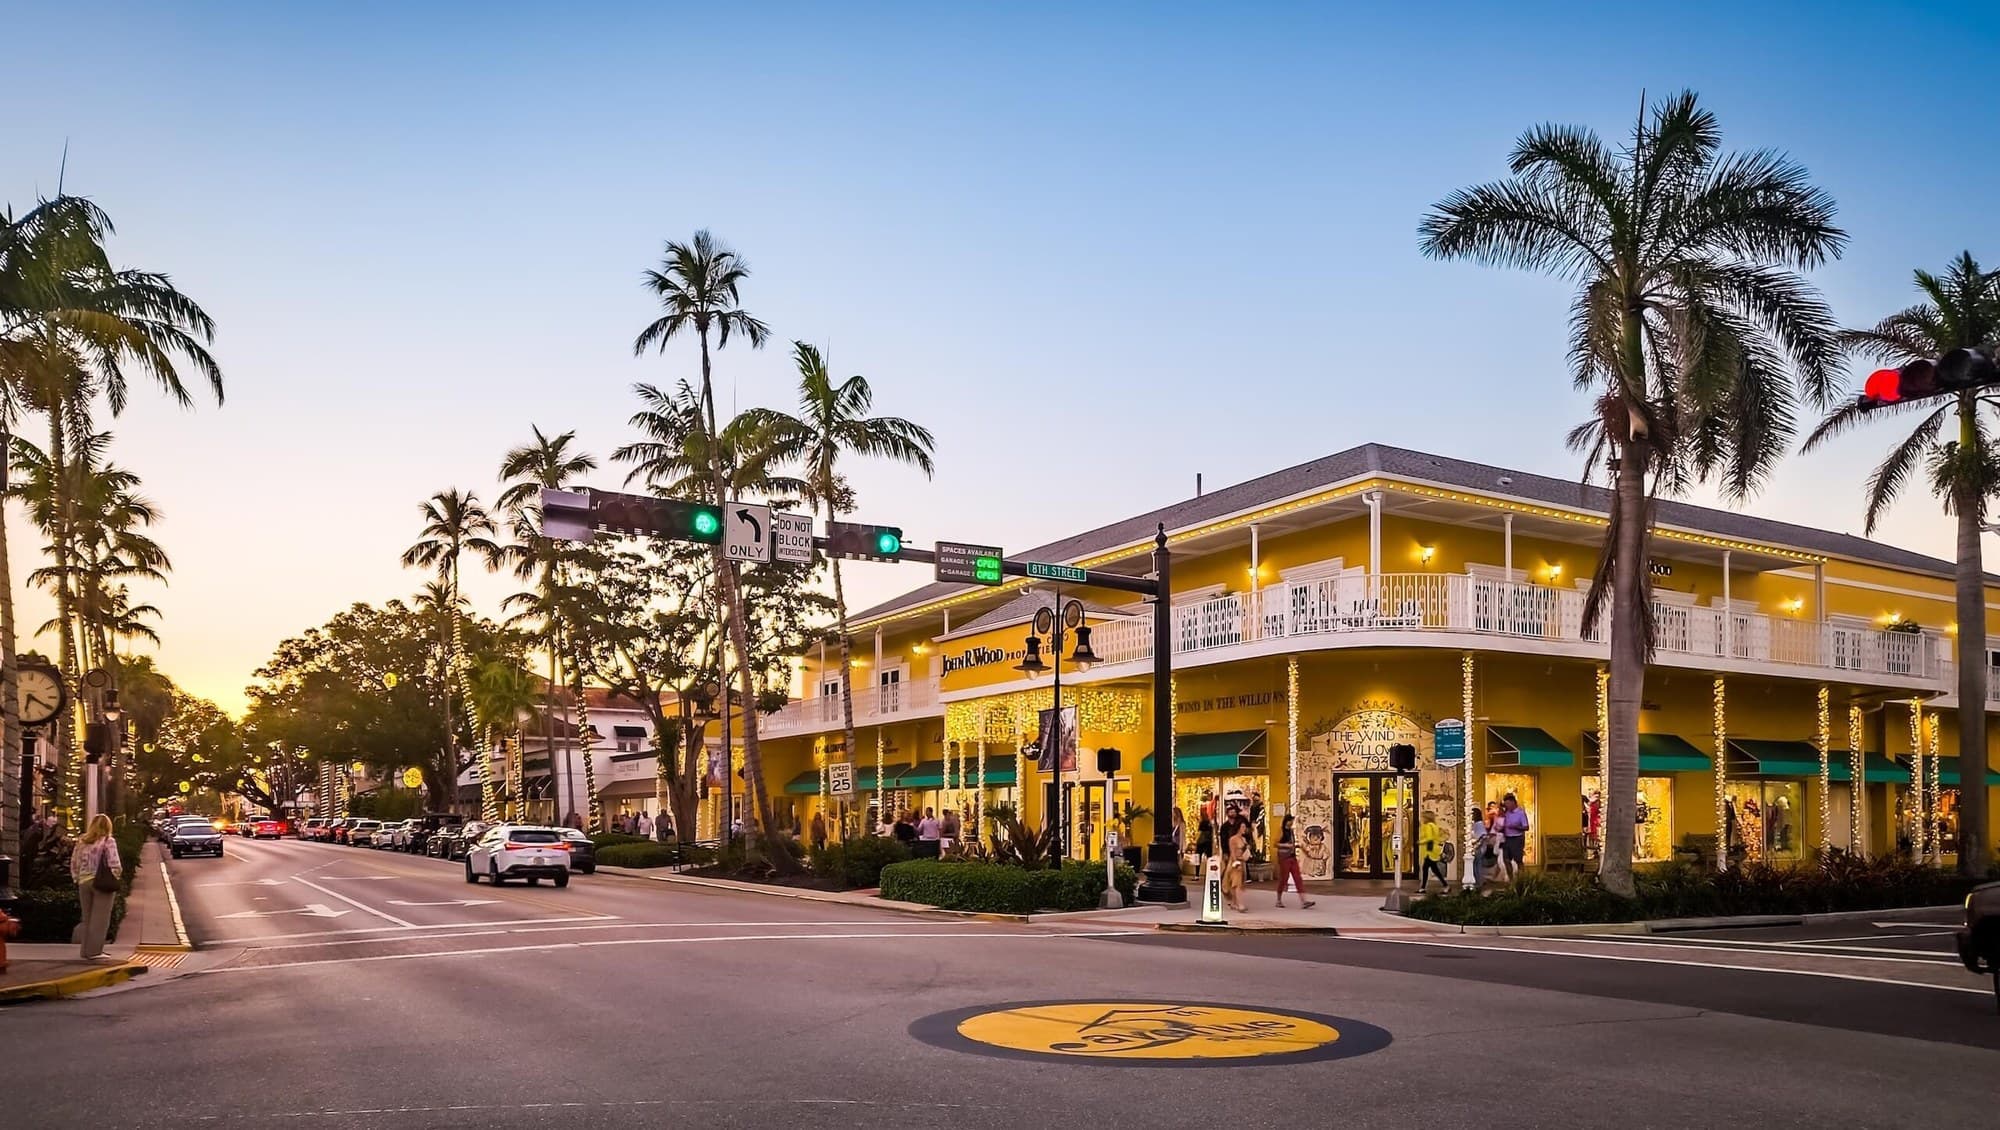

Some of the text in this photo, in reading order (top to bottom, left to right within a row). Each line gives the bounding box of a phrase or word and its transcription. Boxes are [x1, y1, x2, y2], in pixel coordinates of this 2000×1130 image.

[780, 520, 811, 533] DO NOT
[779, 535, 810, 547] BLOCK
[730, 544, 764, 557] ONLY
[779, 548, 810, 557] INTERSECTION
[942, 546, 999, 558] SPACES AVAILABLE
[940, 557, 964, 565] GARAGE
[976, 558, 999, 569] OPEN
[947, 569, 971, 577] GARAGE
[976, 570, 999, 580] OPEN
[1031, 564, 1081, 579] 8TH STREET
[941, 654, 964, 677] JOHN
[974, 646, 1004, 669] WOOD
[1177, 691, 1285, 713] WIND IN THE WILLOWS
[1333, 731, 1355, 741] THE
[1357, 731, 1396, 742] WIND
[1361, 756, 1389, 771] 793
[832, 779, 850, 792] 25
